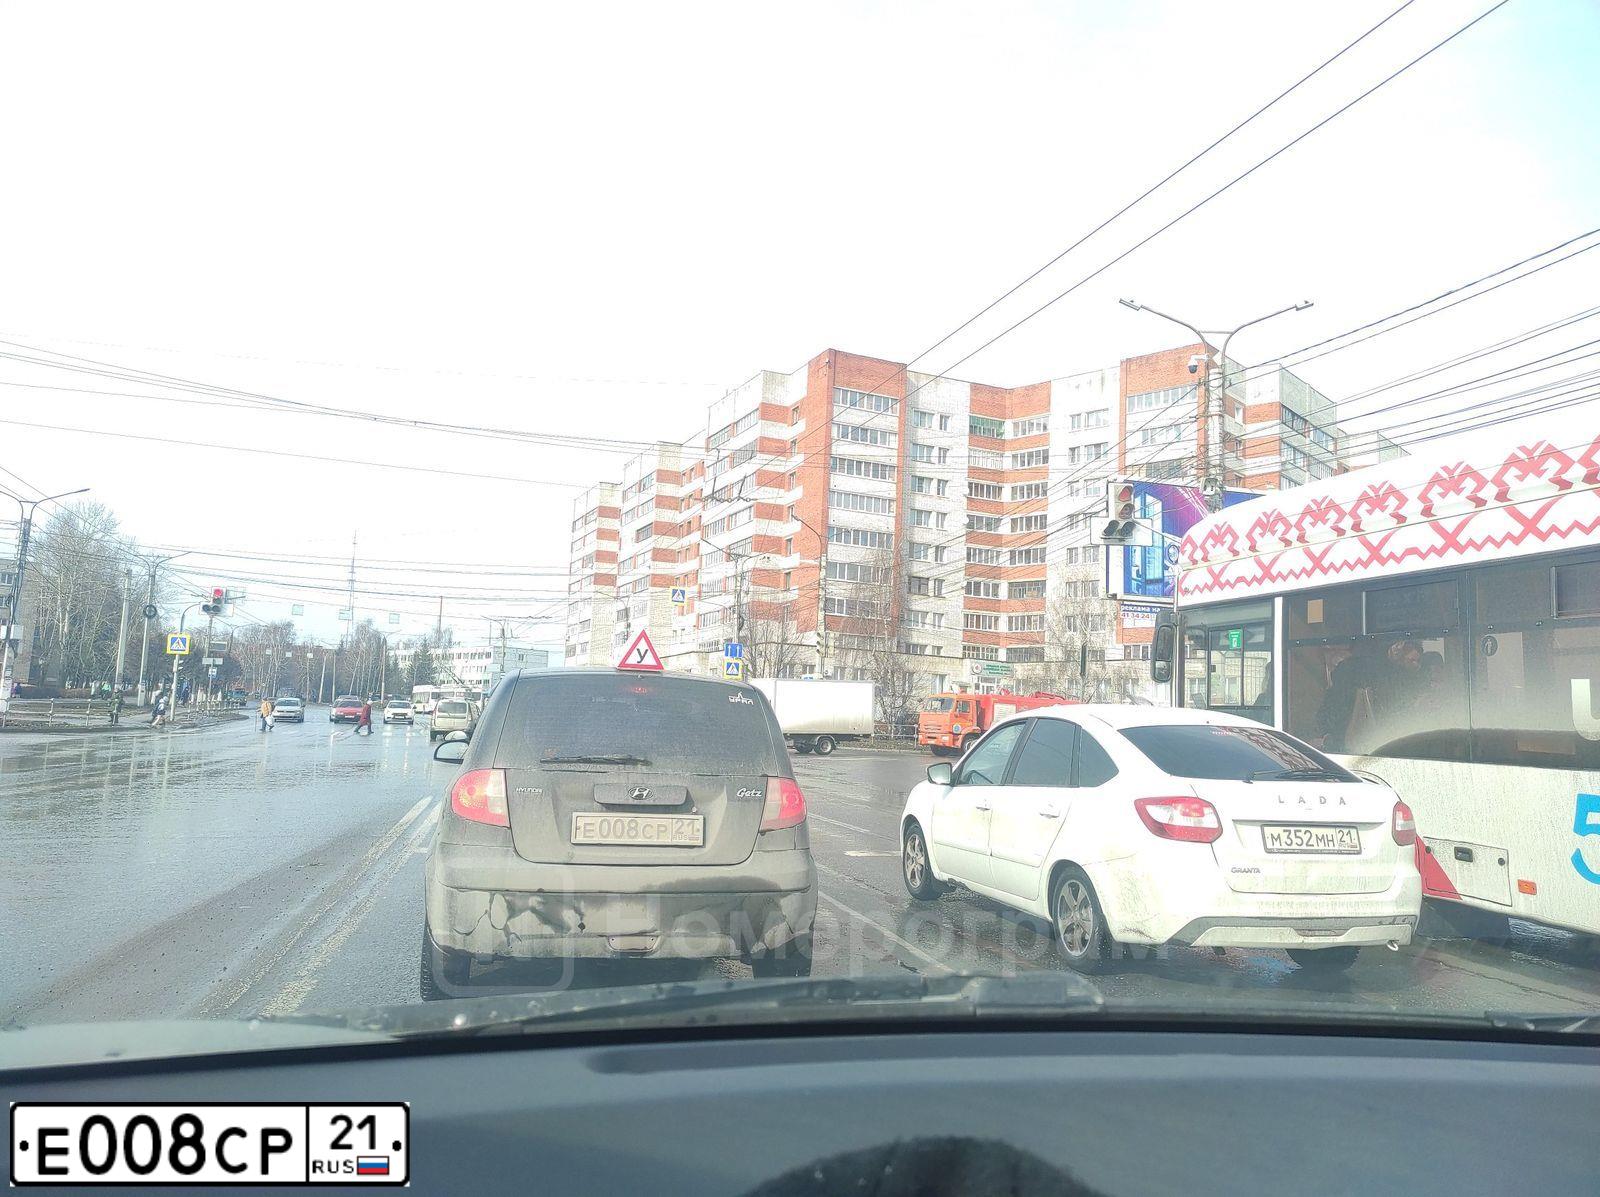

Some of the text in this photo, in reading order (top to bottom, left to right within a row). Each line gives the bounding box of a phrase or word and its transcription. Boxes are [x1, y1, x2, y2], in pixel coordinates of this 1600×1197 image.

[737, 787, 762, 798] Getz
[1278, 795, 1346, 805] LADA
[675, 818, 697, 836] 21
[1337, 829, 1353, 844] 21
